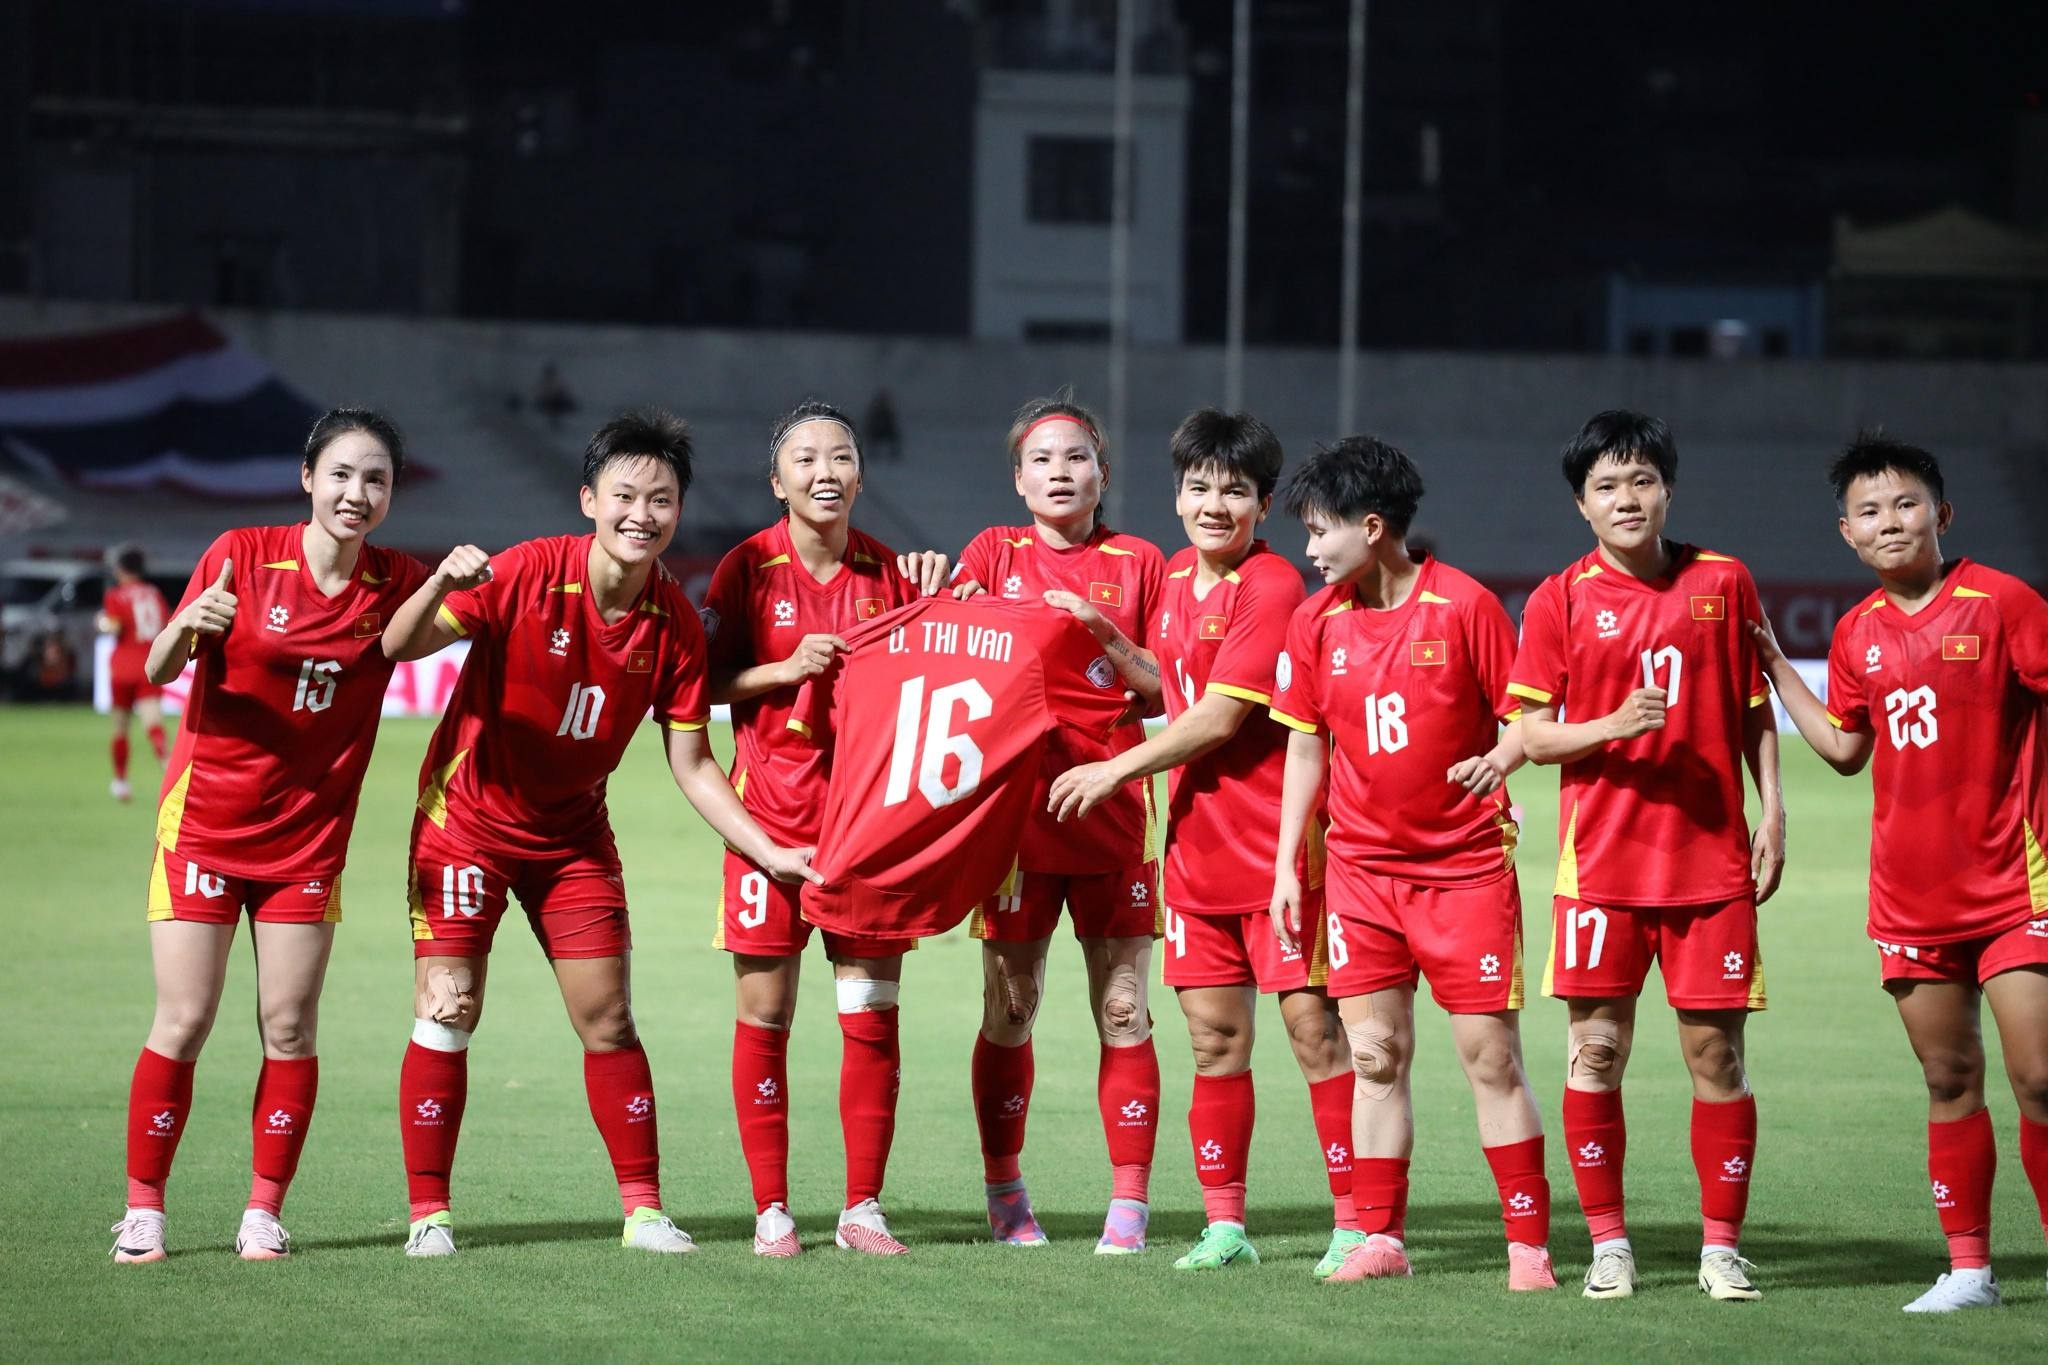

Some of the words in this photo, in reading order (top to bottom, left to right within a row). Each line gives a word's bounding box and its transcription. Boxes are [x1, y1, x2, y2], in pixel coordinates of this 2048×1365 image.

[921, 621, 958, 655] THI
[967, 625, 1013, 662] VAN
[292, 656, 343, 713] 15
[1640, 644, 1683, 709] 17
[555, 681, 606, 741] 10
[1364, 690, 1408, 757] 18
[1884, 684, 1939, 752] 23
[883, 674, 993, 810] 16
[442, 863, 485, 919] 10
[736, 870, 769, 930] 9
[1164, 905, 1185, 960] 4
[1565, 907, 1608, 971] 17
